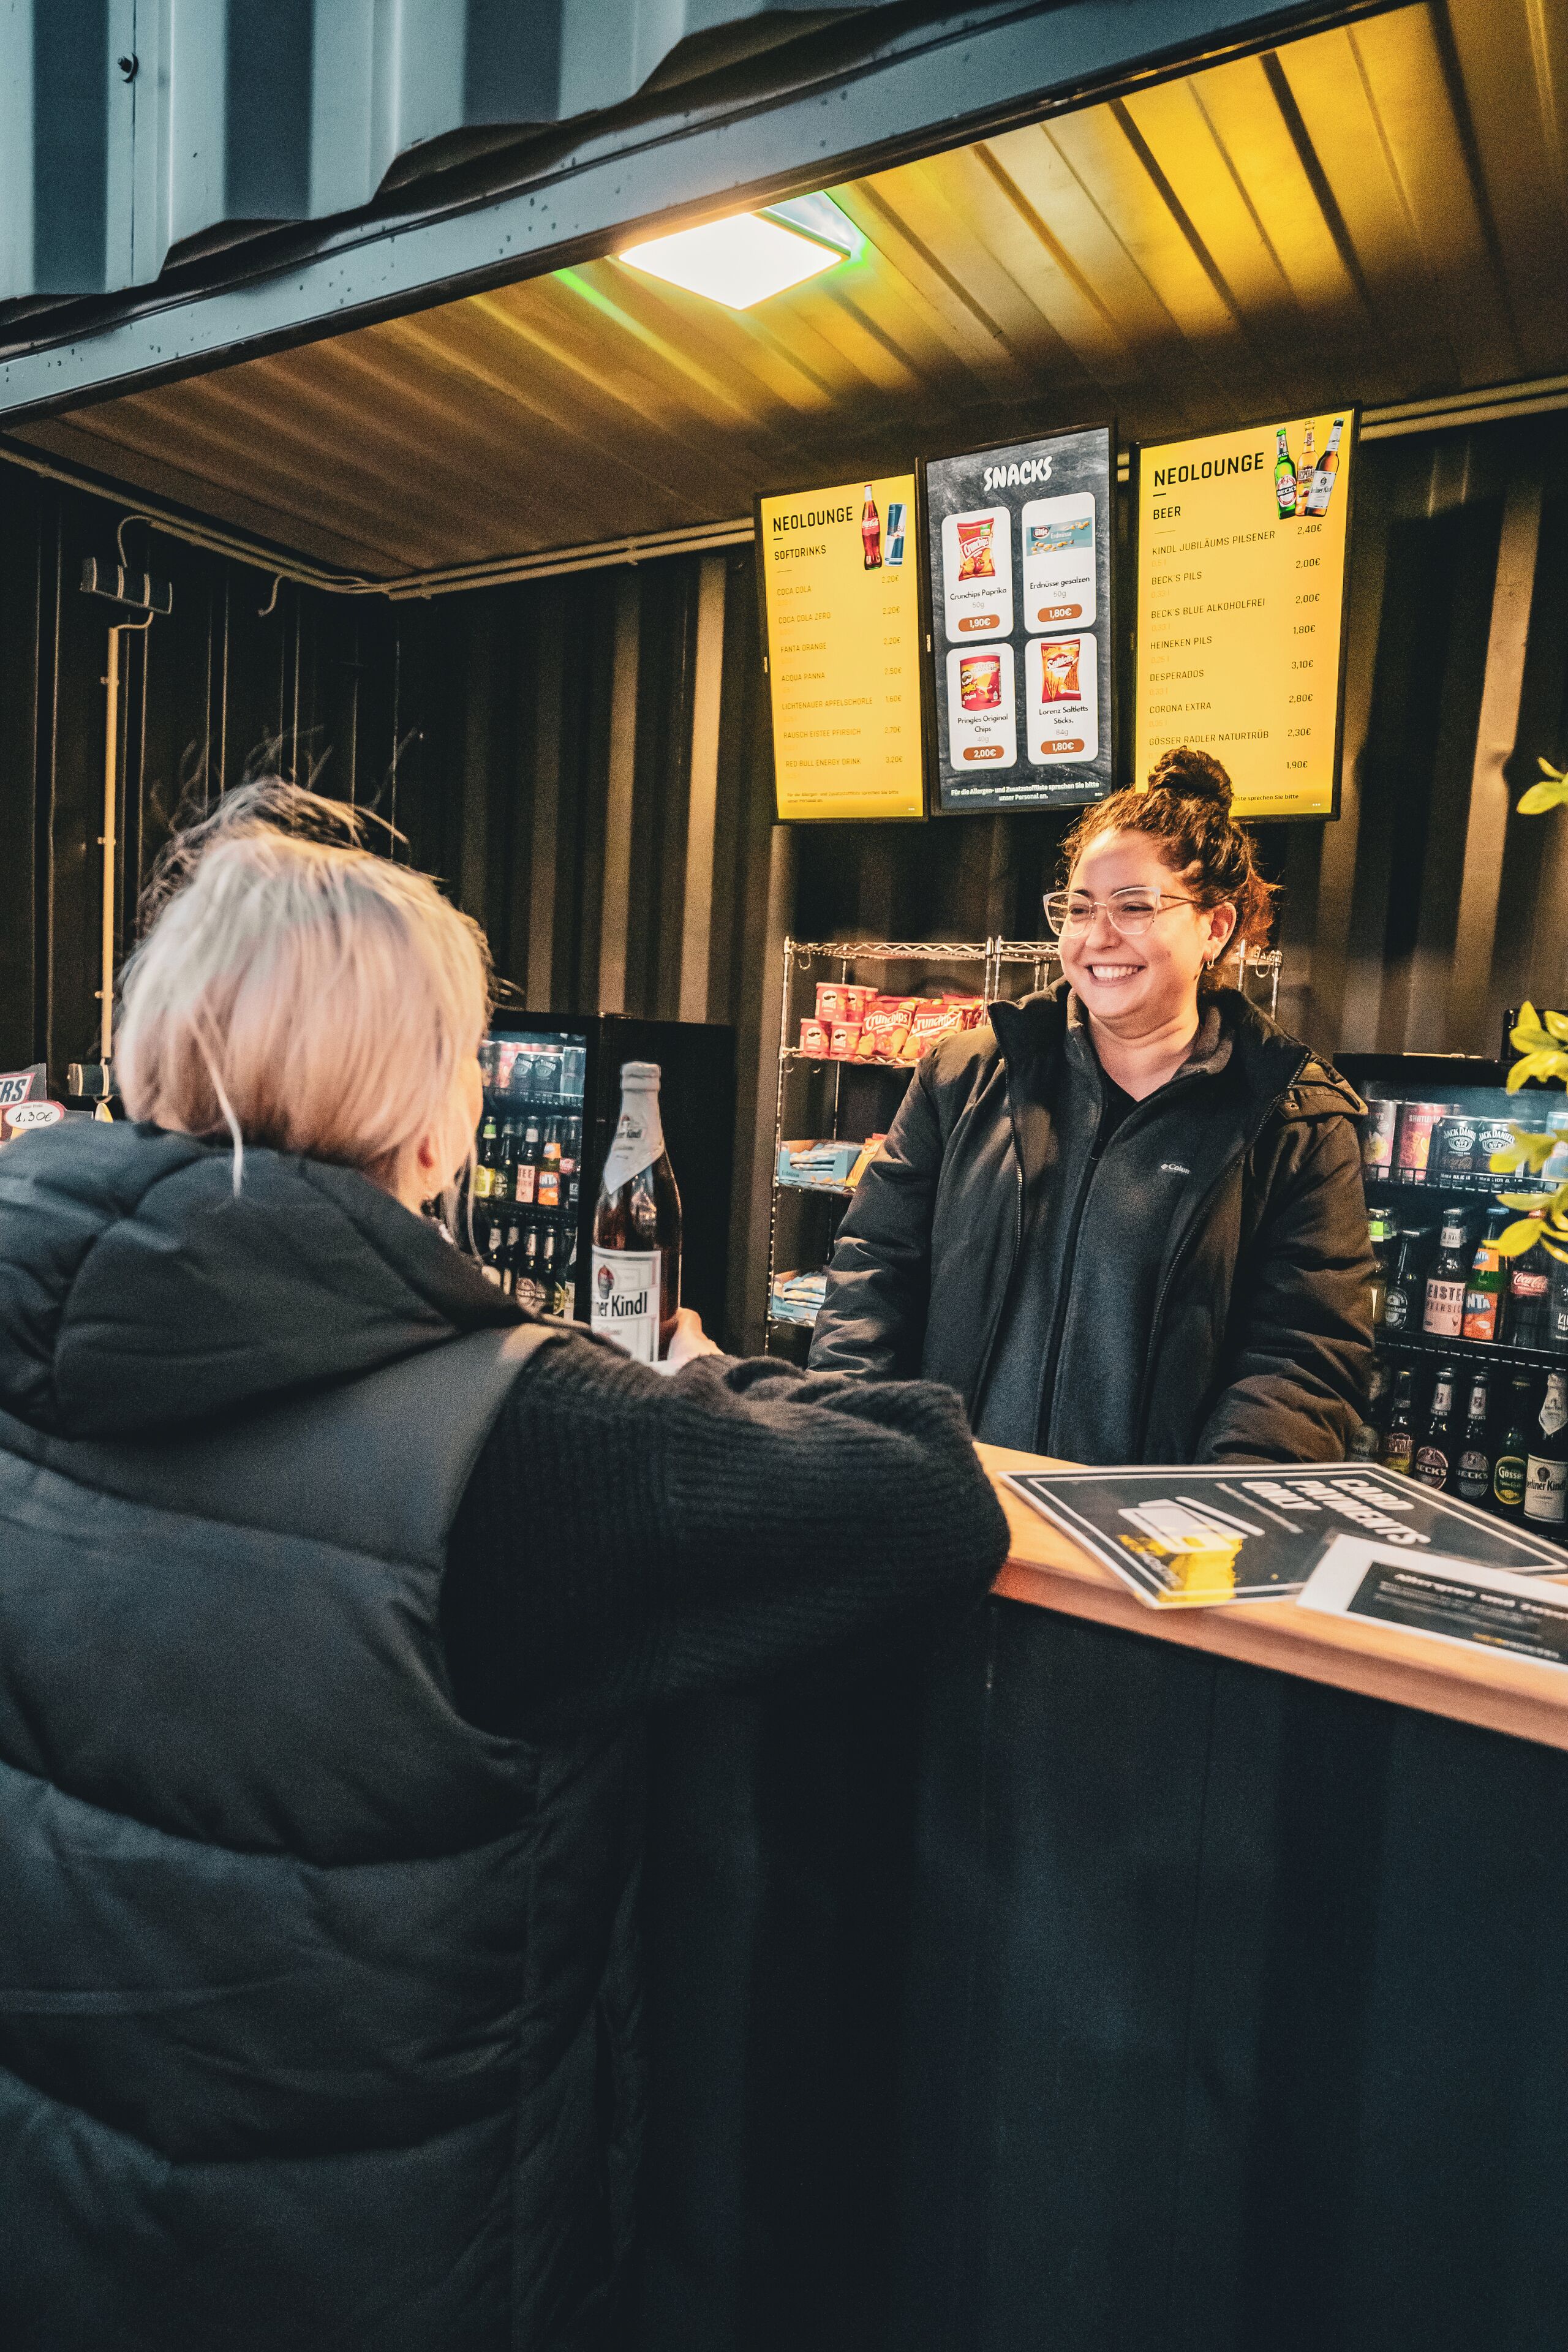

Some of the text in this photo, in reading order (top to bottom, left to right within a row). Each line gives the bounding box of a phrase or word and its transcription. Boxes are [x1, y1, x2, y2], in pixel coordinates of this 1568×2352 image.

[984, 456, 1052, 491] SNACKS
[1154, 452, 1264, 487] NEOLOUNGE
[773, 506, 853, 532] NEOLOUNGE
[1153, 506, 1181, 520] BEER
[1152, 524, 1322, 555] KINDL JUBILÄUMS PILSENER 2,40€
[774, 545, 826, 560] SOFTDRINKS
[1184, 571, 1202, 581] PILS
[1295, 558, 1321, 568] 2,00€
[1030, 576, 1090, 590] Erdnüsse gesalzen
[777, 587, 793, 596] COCA
[796, 585, 812, 594] COLA
[950, 587, 1007, 601] Crunchips Paprika
[1054, 590, 1066, 598] 50g
[1183, 605, 1204, 615] BLUE
[1207, 598, 1265, 612] ALKOHOLFREI
[1295, 594, 1320, 604] 2,00€
[778, 616, 795, 624] COCA
[797, 614, 813, 622] COLA
[815, 612, 831, 620] ZERO
[1049, 608, 1072, 619] 1,80€
[970, 617, 990, 628] 1,90€
[1150, 625, 1316, 649] HEINEKEN PILS 1,80€
[781, 644, 800, 653] FANTA
[802, 643, 827, 651] ORANGE
[782, 674, 802, 682] ACQUA
[804, 672, 825, 680] PANNA
[1150, 660, 1314, 682] DESPERADOS 3,10€
[782, 701, 823, 710] LICHTENAUER
[824, 697, 873, 706] APFELSCHORLE
[1150, 694, 1313, 714] CORONA EXTRA 2,80€
[957, 713, 1008, 726] Pringles Original
[974, 725, 991, 734] Chips
[1149, 728, 1311, 745] GÖSSER RADLER NATURTRÜB 2,30€
[973, 749, 997, 758] 2,00€
[1052, 742, 1074, 752] 1,80€
[1286, 760, 1308, 769] 1,90€
[970, 787, 994, 796] Allergen-
[864, 1012, 908, 1030] Crunchips
[1444, 1127, 1477, 1142] JACK DANIEL
[1479, 1130, 1491, 1142] JACK
[1475, 1251, 1489, 1260] NTA
[612, 1291, 647, 1317] Kindl
[1466, 1294, 1491, 1310] NTA
[1241, 1481, 1322, 1510] ONLY
[1330, 1479, 1415, 1510] CARD
[1284, 1480, 1431, 1545] PAYMENTS
